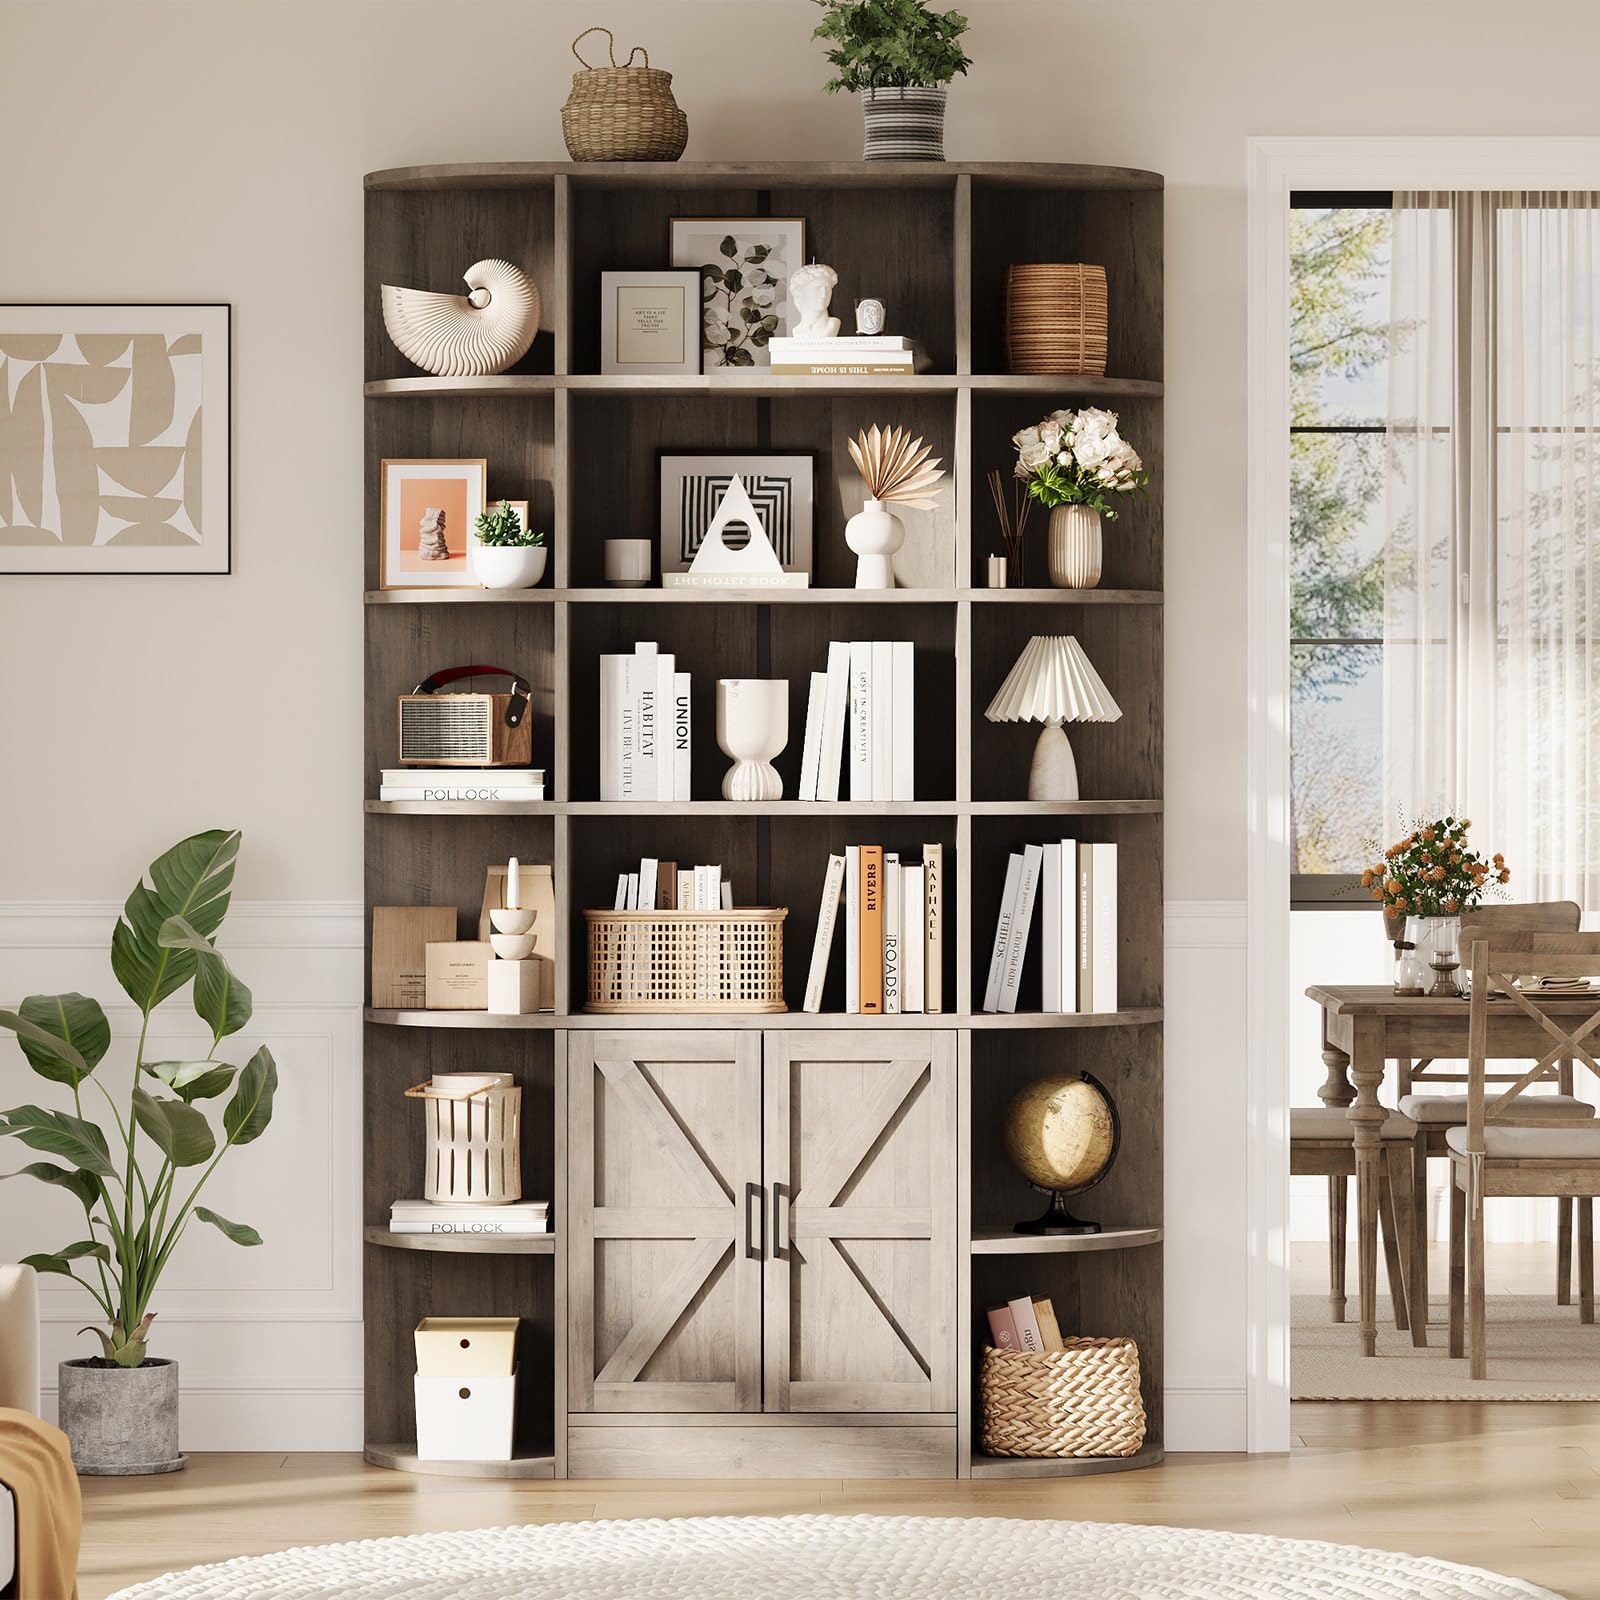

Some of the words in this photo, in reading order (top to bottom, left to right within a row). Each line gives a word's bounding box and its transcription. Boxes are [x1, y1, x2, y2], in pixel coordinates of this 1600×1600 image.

[811, 366, 837, 374] HOME
[839, 366, 847, 374] IS
[849, 366, 869, 374] THIS
[860, 697, 867, 706] IN
[623, 709, 632, 734] LIVE
[642, 691, 654, 758] HABITAT
[676, 696, 688, 750] UNION
[623, 737, 632, 797] BEAUTIFUL
[424, 788, 500, 801] POLLOCK
[867, 863, 876, 911] RIVERS
[928, 860, 937, 940] RAPHAEL
[1020, 892, 1028, 915] second
[1024, 869, 1032, 891] glance
[996, 912, 1011, 959] SCHIELE
[1011, 929, 1023, 967] PICOULT
[885, 938, 897, 997] ROADS
[1007, 967, 1016, 988] JODI
[432, 1223, 504, 1233] POLLOCK
